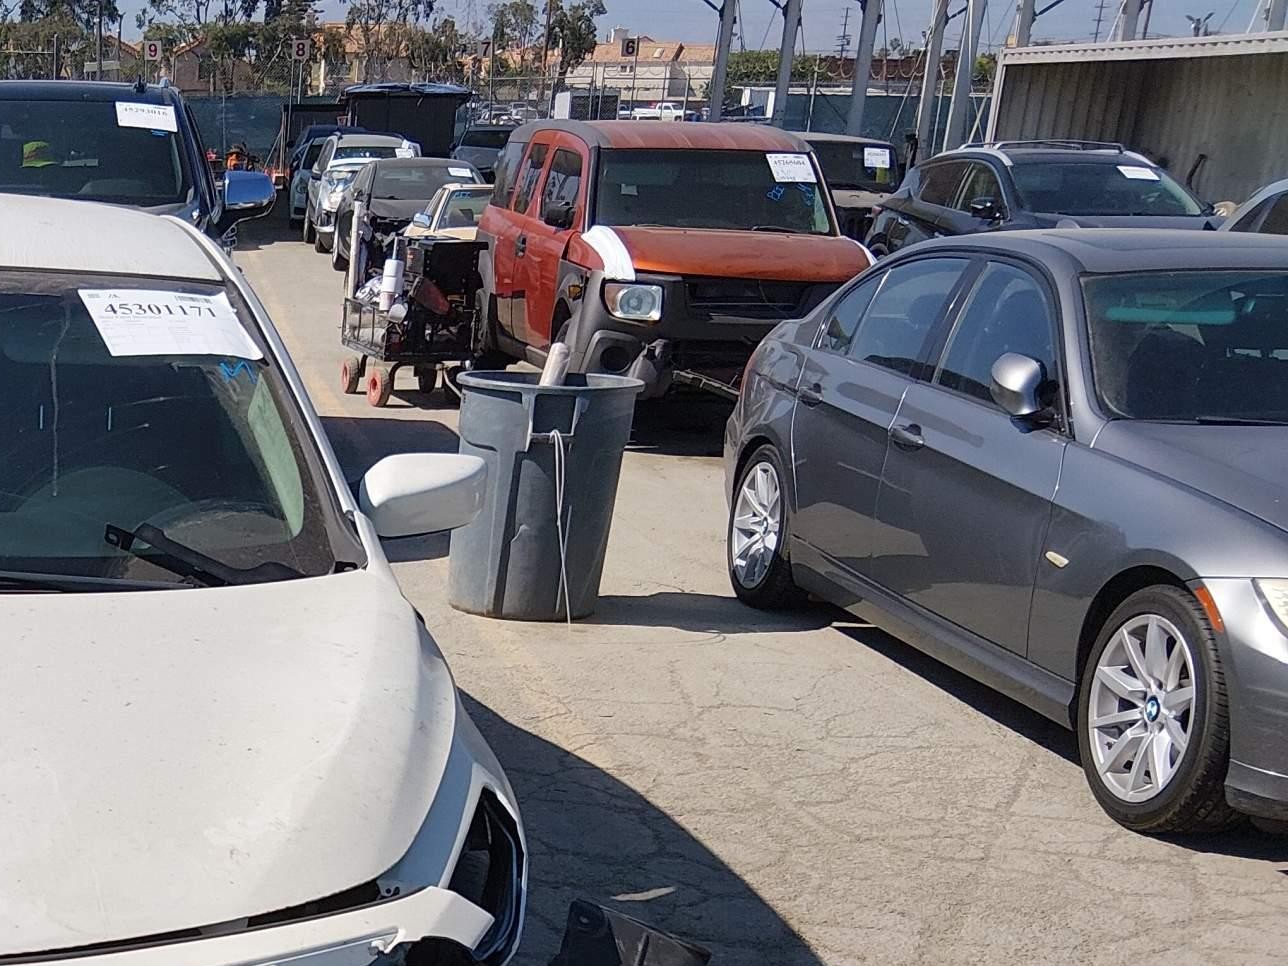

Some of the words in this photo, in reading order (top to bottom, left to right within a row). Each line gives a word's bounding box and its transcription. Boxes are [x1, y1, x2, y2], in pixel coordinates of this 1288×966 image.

[148, 43, 157, 57] 9
[296, 42, 305, 57] 8
[481, 41, 491, 56] 7
[626, 41, 635, 55] 6
[104, 302, 217, 318] 45301171
